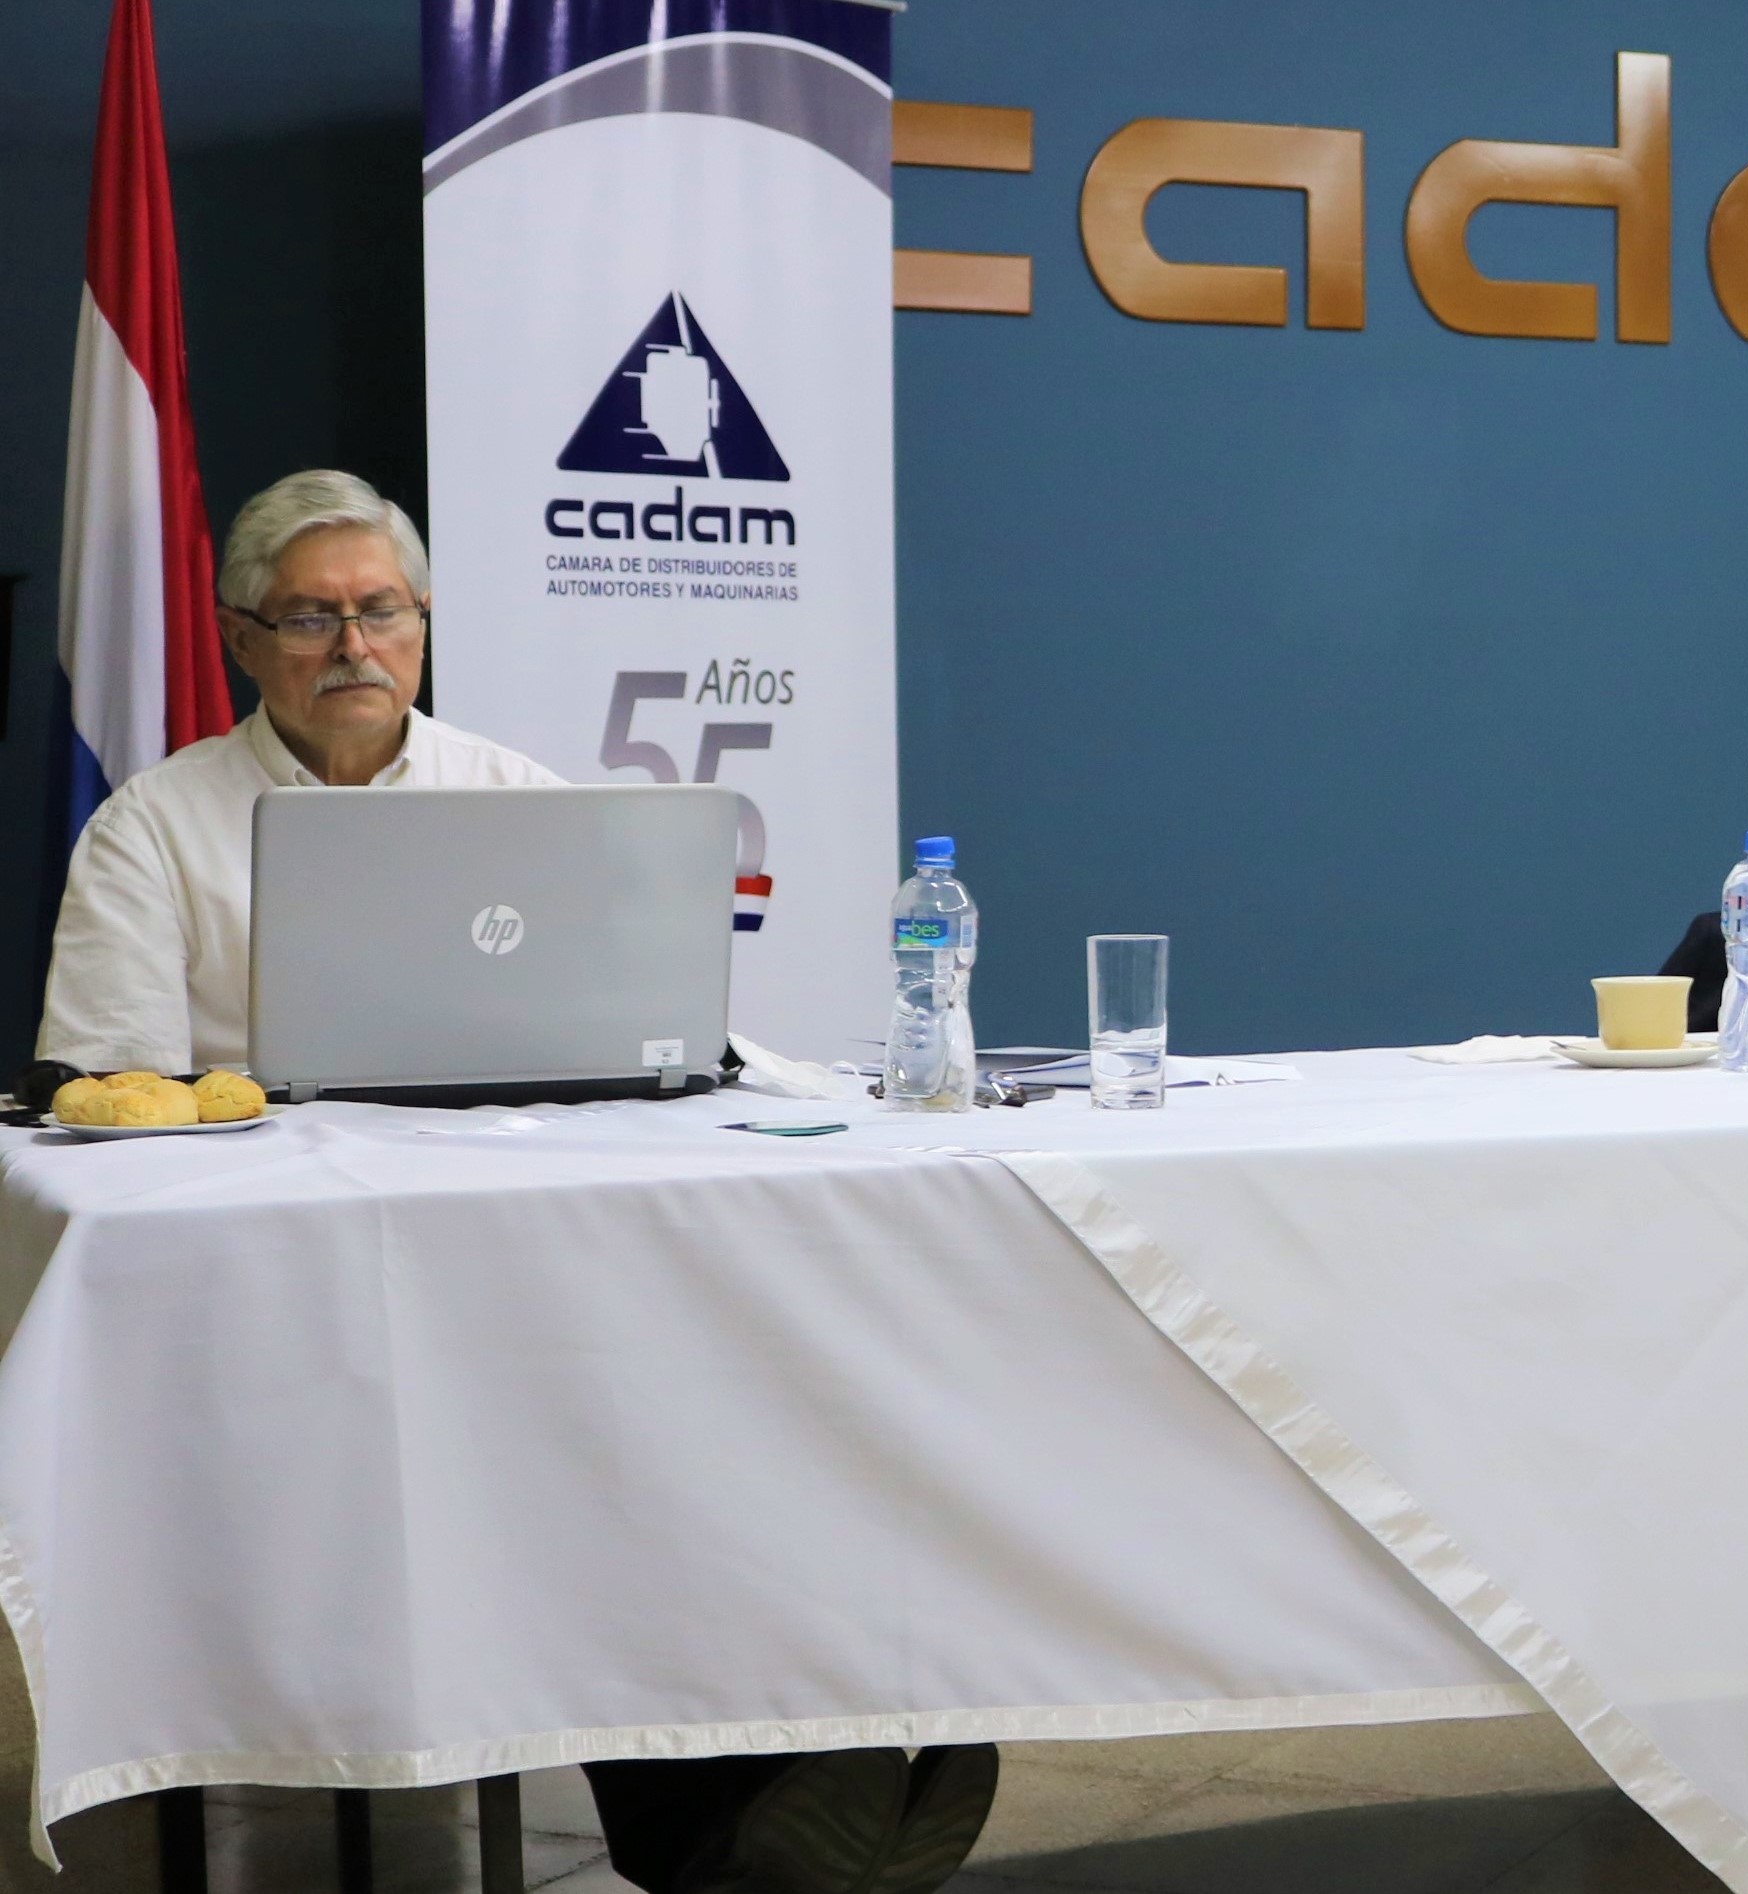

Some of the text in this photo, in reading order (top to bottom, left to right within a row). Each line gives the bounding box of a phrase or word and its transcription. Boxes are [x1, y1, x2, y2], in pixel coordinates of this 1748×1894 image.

[545, 485, 796, 546] cadam
[546, 555, 797, 578] CAMARA DE DISTRIBUIDORES DE
[547, 580, 798, 601] AUTOMOTORES Y MAQUINARIAS
[695, 657, 795, 705] Años
[478, 904, 519, 956] hp
